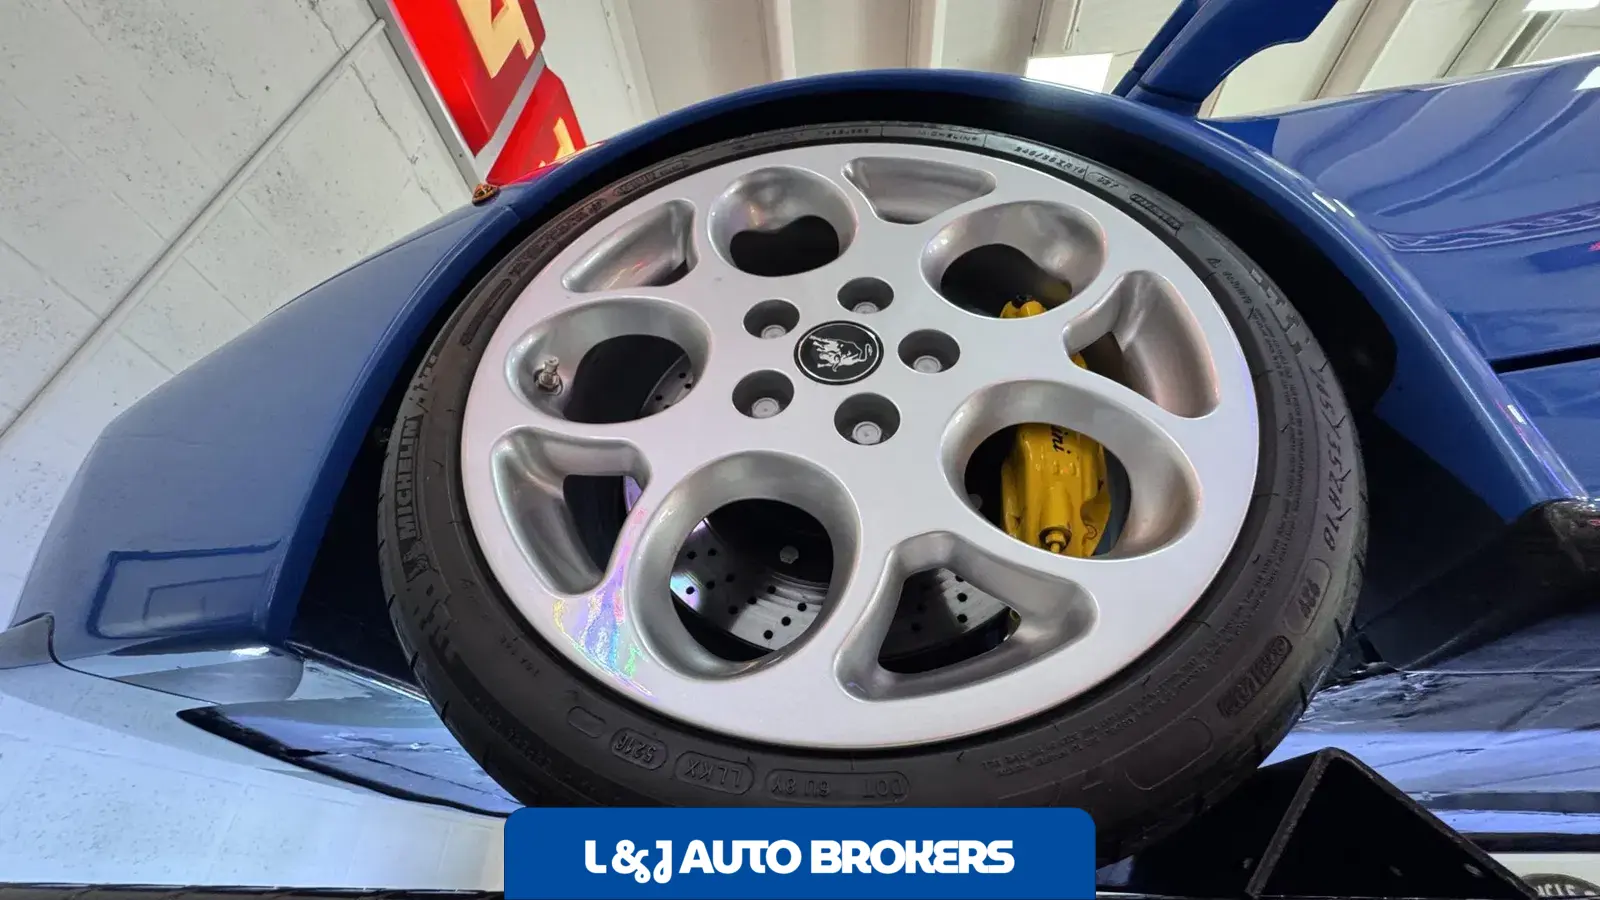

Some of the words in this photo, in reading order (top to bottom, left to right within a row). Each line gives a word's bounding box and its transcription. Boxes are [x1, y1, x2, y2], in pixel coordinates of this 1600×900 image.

[397, 418, 418, 540] MICHELIN
[684, 758, 743, 788] LLKX
[863, 779, 905, 799] DOT
